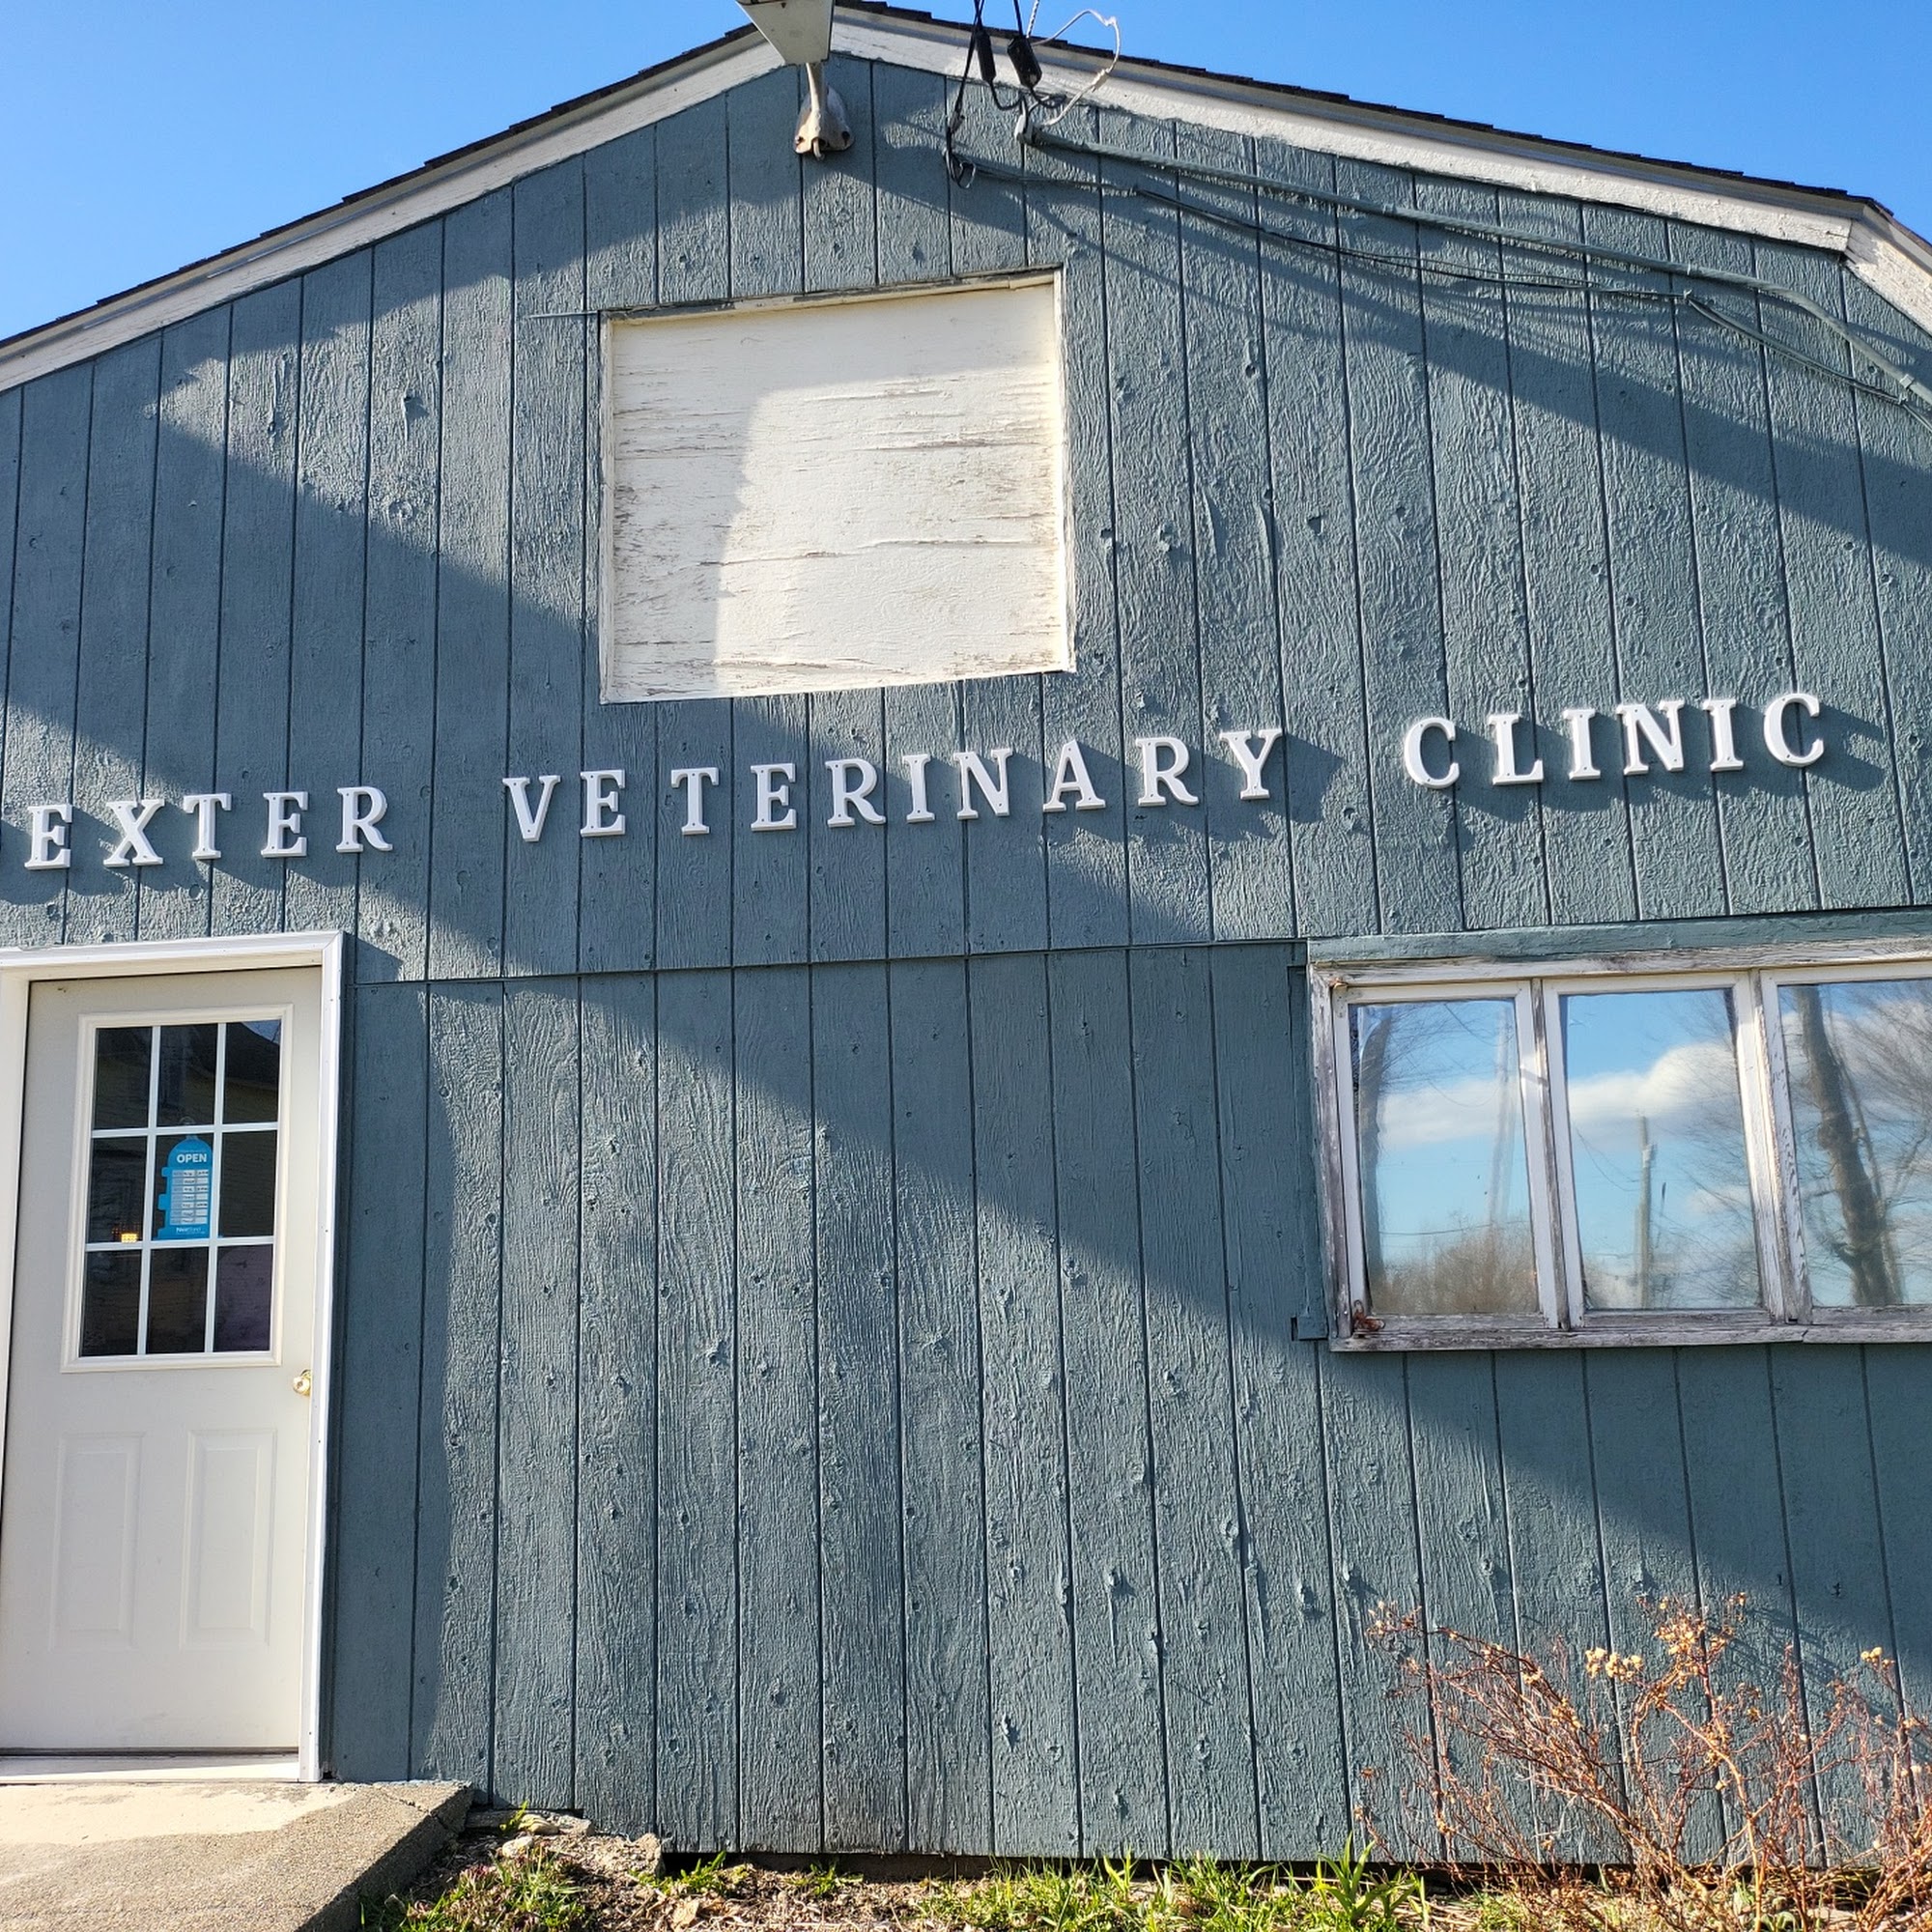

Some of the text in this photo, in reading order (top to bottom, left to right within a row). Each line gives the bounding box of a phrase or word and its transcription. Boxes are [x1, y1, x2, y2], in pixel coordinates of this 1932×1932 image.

[24, 693, 1825, 869] EXTER VETERINARY CLINIC
[177, 1153, 207, 1163] OPEN
